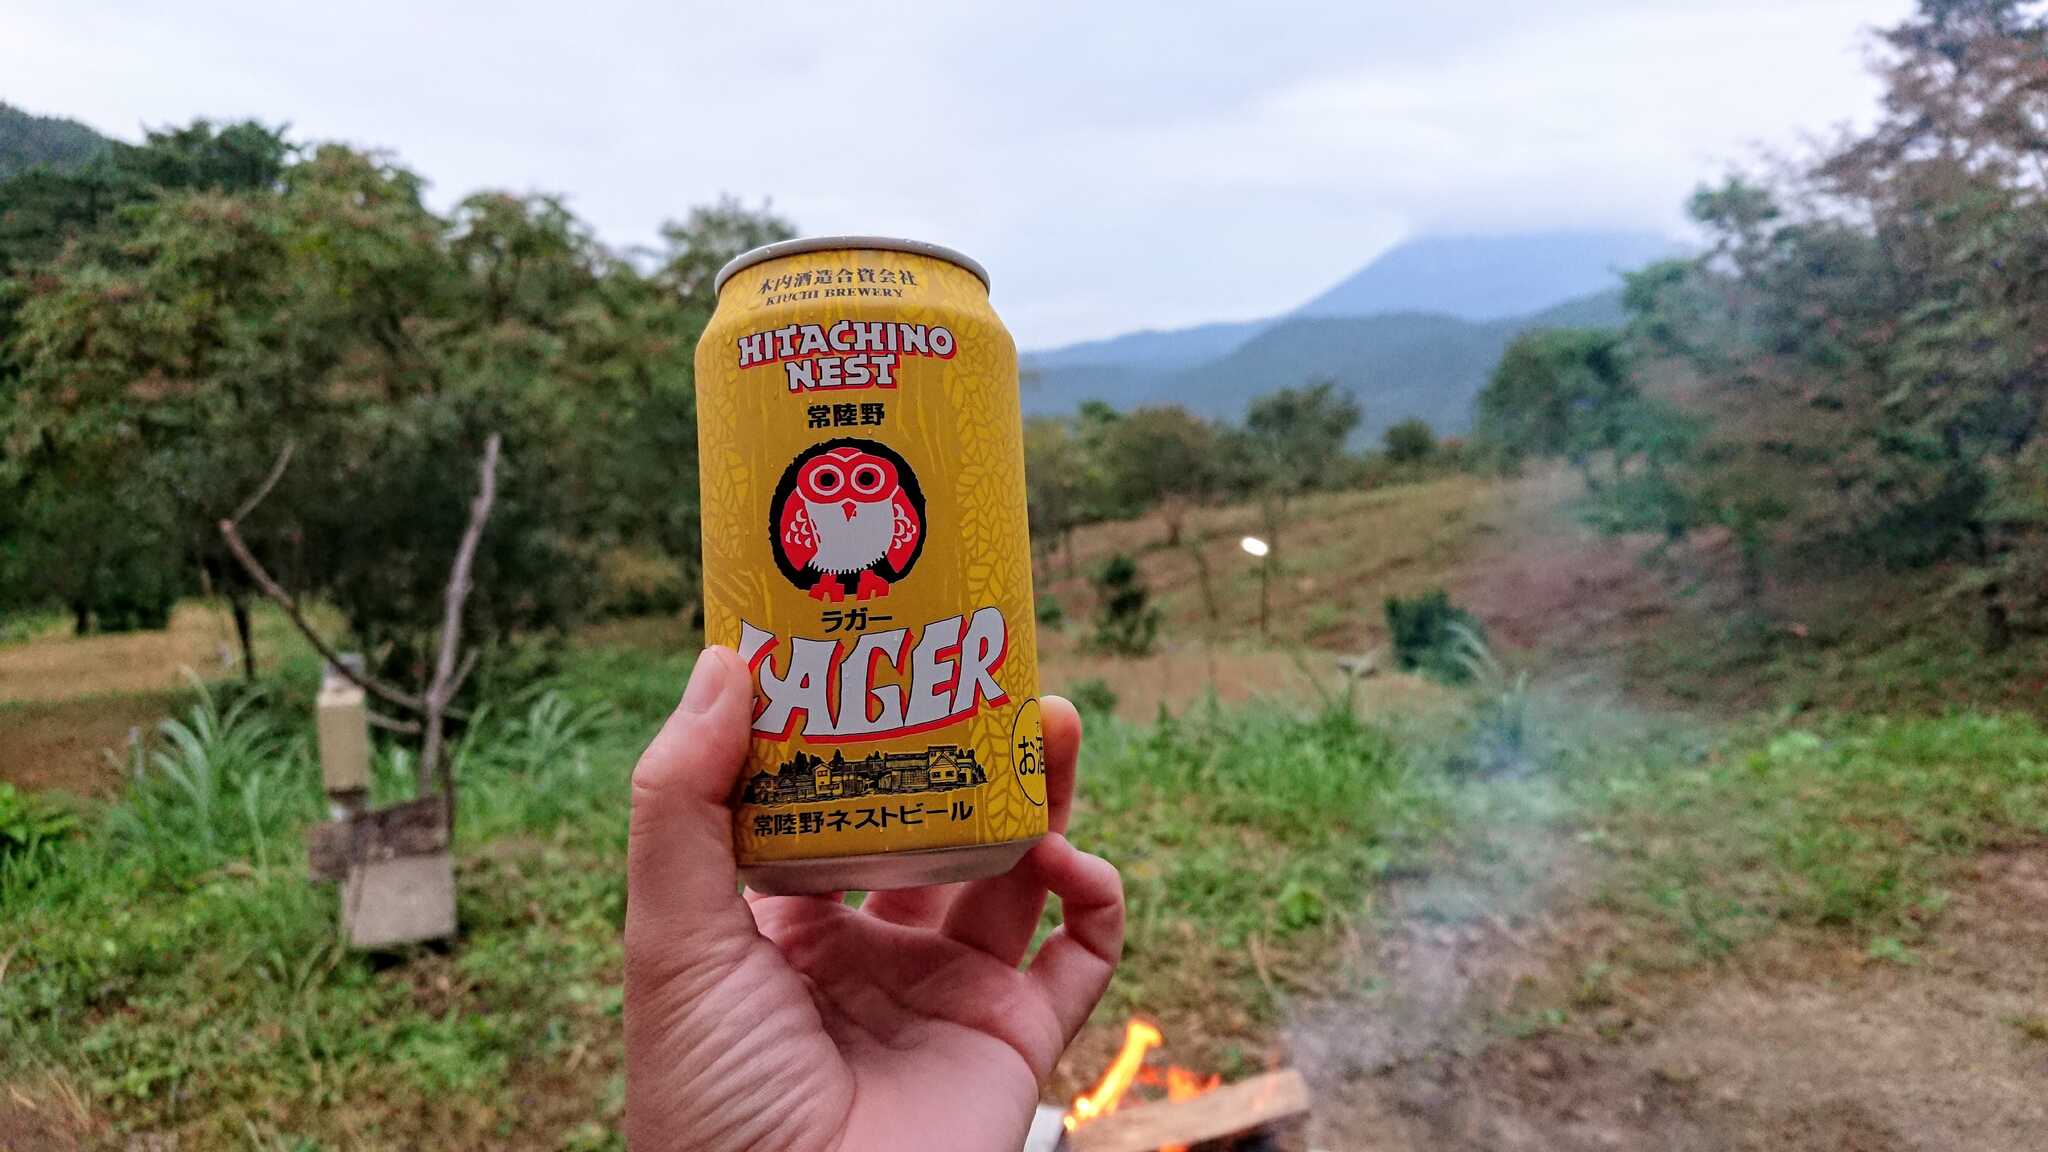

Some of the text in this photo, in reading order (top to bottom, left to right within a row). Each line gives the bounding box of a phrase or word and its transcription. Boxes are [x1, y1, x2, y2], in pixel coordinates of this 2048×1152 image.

[758, 268, 918, 294] 木内酒造合資会社
[766, 288, 904, 306] KIUCHI BREWERY
[738, 320, 957, 368] HITACHINO
[784, 354, 898, 392] NEST
[808, 403, 885, 428] 常陸野
[821, 607, 893, 633] ラガー
[753, 802, 973, 837] 常陸野ネストビール
